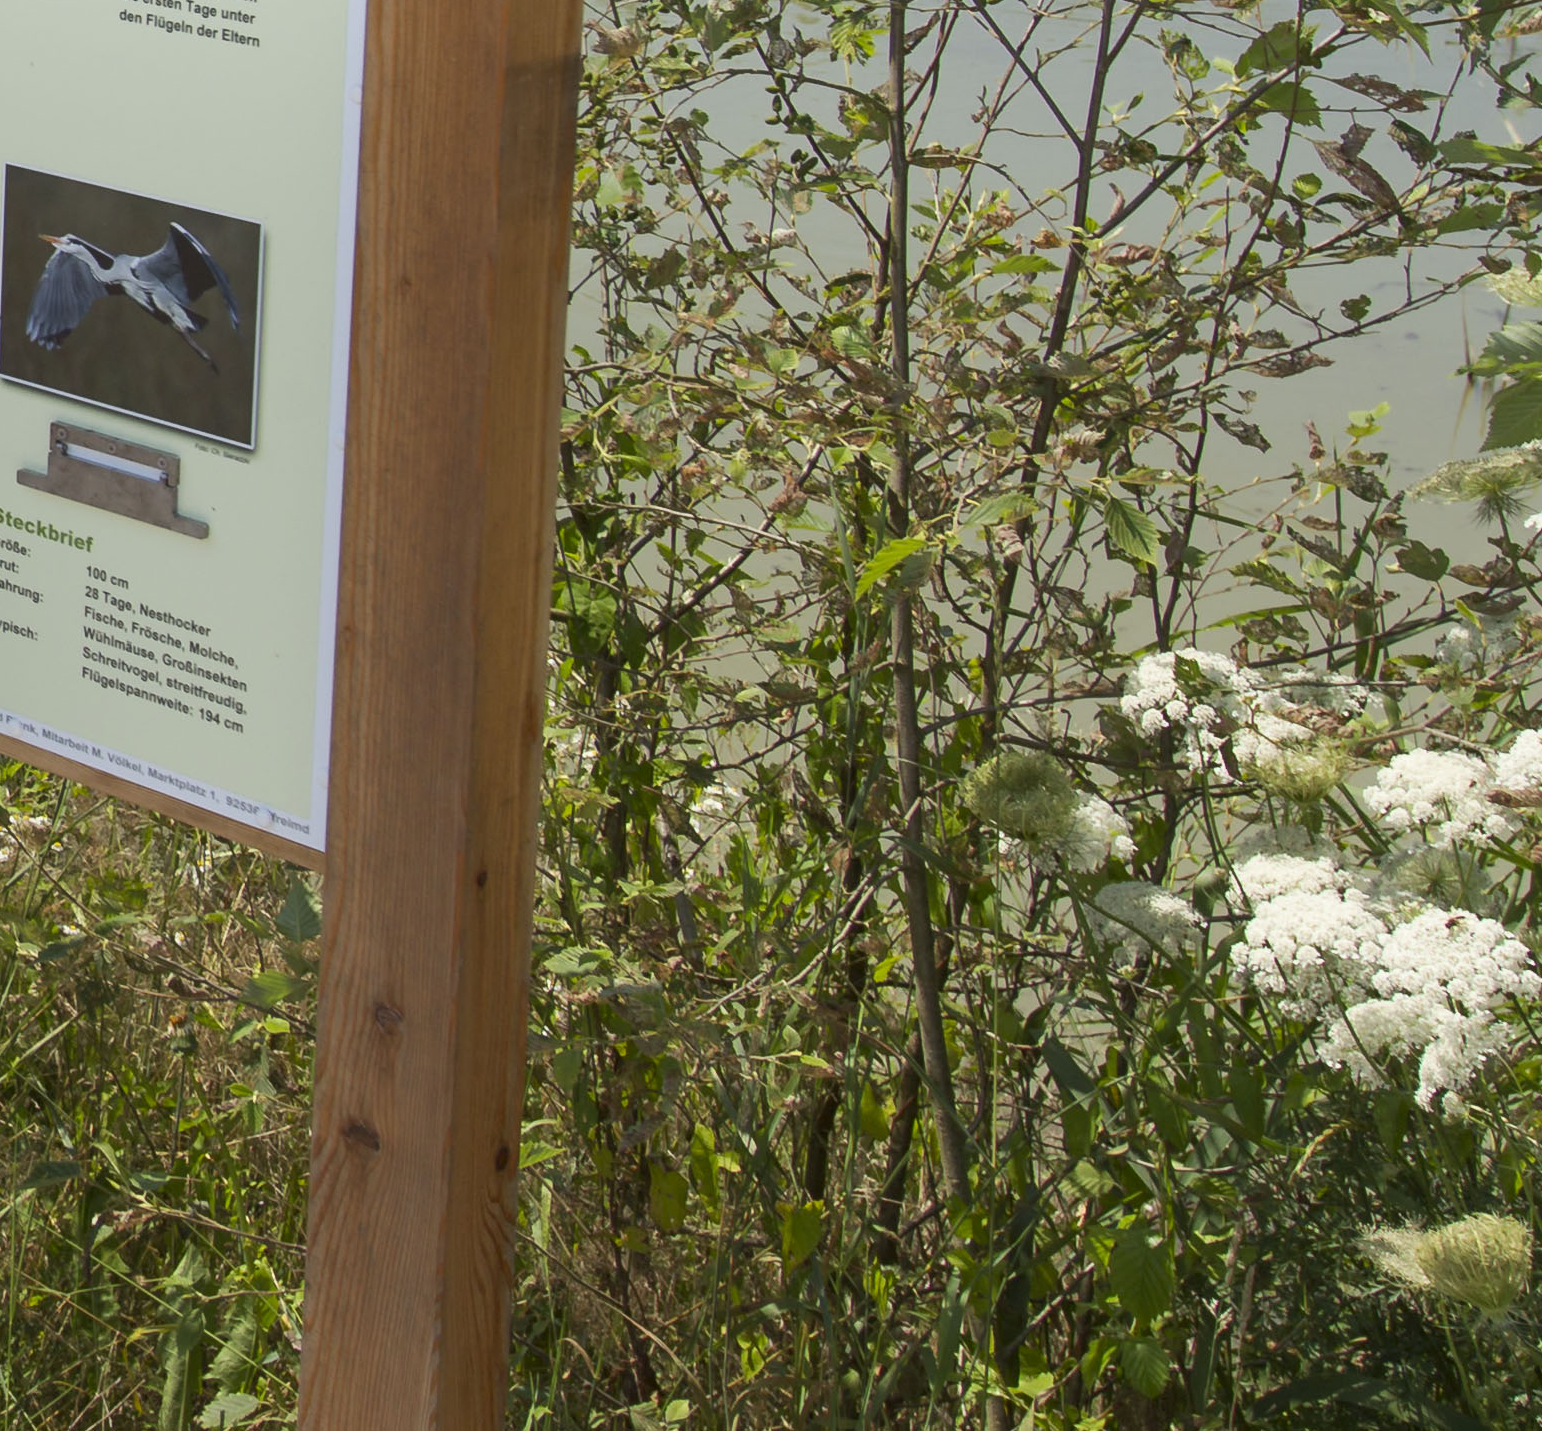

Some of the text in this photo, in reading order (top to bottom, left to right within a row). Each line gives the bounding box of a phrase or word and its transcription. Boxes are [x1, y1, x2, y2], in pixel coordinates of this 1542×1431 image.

[186, 0, 217, 18] Tage
[221, 7, 256, 25] unter
[85, 586, 211, 637] 28 Tage, Nesthocker
[85, 607, 239, 669] Fische, Frösche, Molche,
[83, 627, 248, 692] Wühlmäuse, Großinsekten
[83, 647, 162, 686] Schreitvogel,
[81, 667, 244, 733] Flügelspannweite: 194 cm
[42, 729, 88, 754] Mitarbeit
[92, 745, 104, 759] M.
[148, 767, 207, 797] Marktplatz
